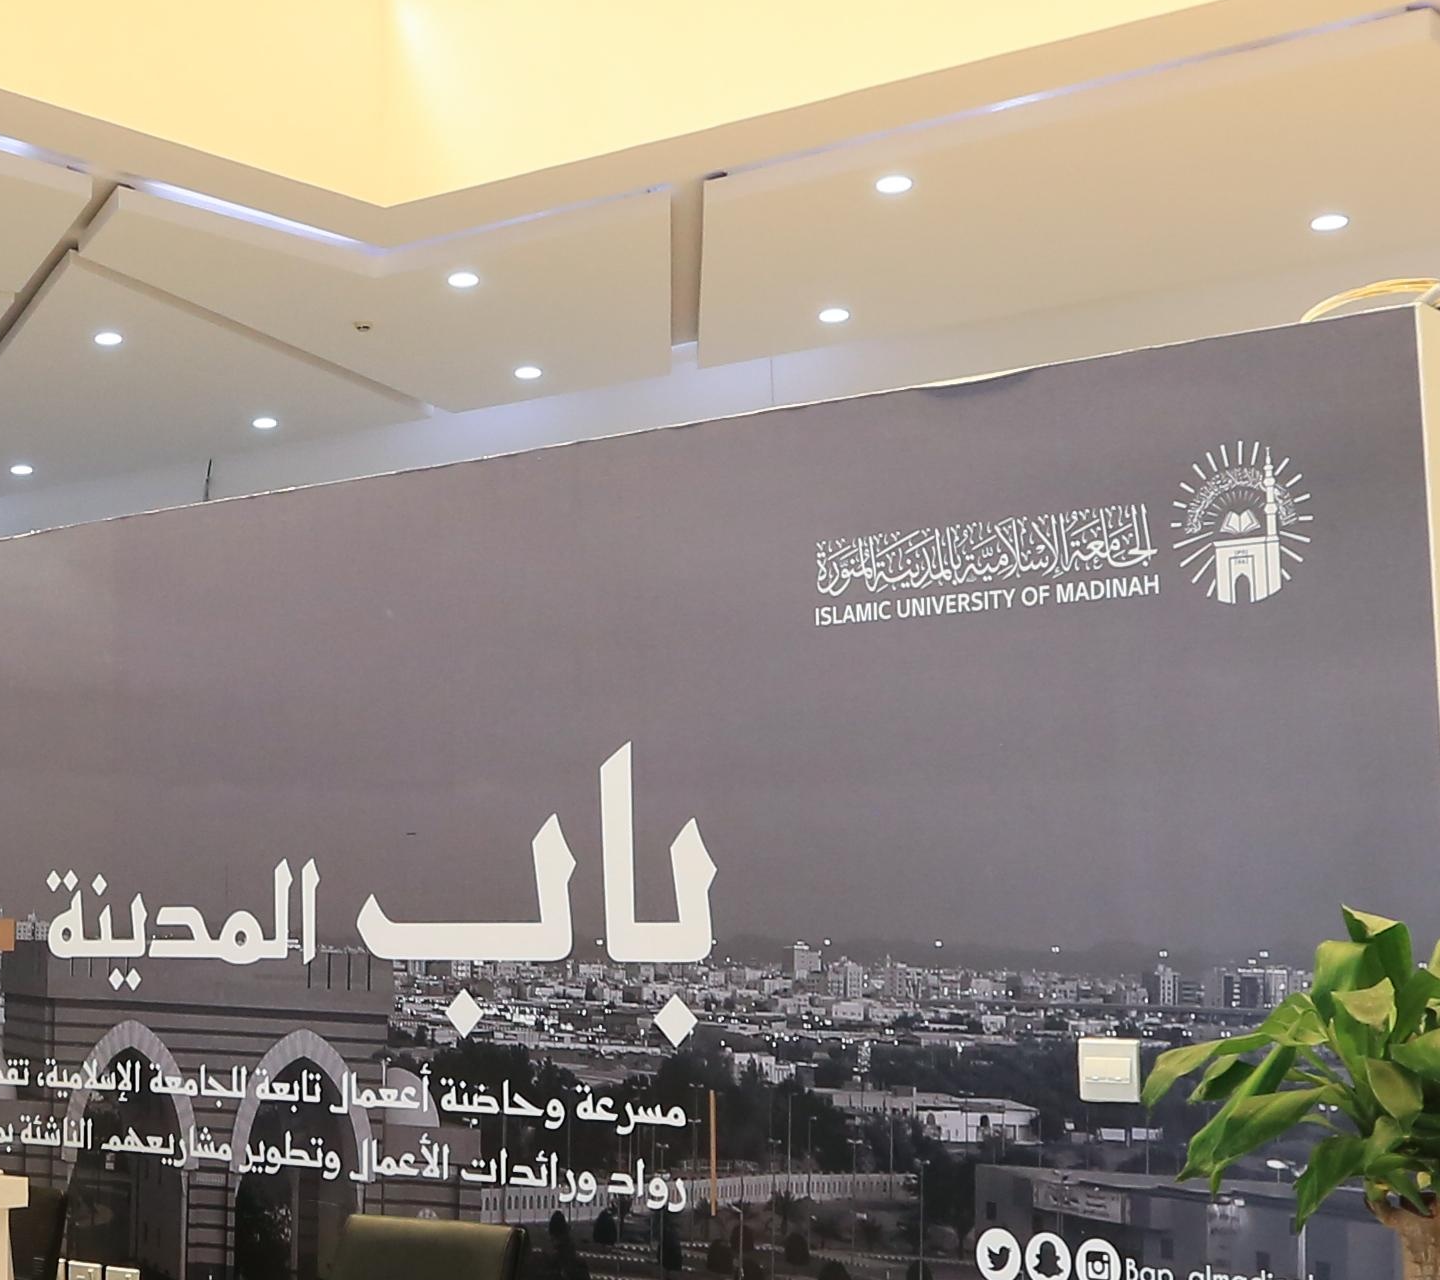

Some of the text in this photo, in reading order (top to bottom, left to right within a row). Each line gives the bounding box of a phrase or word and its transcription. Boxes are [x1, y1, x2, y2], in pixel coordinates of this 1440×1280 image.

[815, 575, 1160, 627] ISLAMIC UNIVERSITY OF MADINAH
[46, 740, 718, 1048] باب المدينة
[149, 1063, 247, 1108] للجامعة
[255, 1068, 322, 1113] تابعة
[439, 1077, 566, 1130] وحاضنة
[575, 1083, 688, 1135] مسرعة
[20, 1114, 93, 1150] الناشئة
[100, 1123, 232, 1168] مشاريعهم
[238, 1130, 341, 1181] وتطوير
[349, 1132, 450, 1182] الأعمال
[459, 1149, 598, 1203] ورائدات
[607, 1158, 688, 1214] رواد
